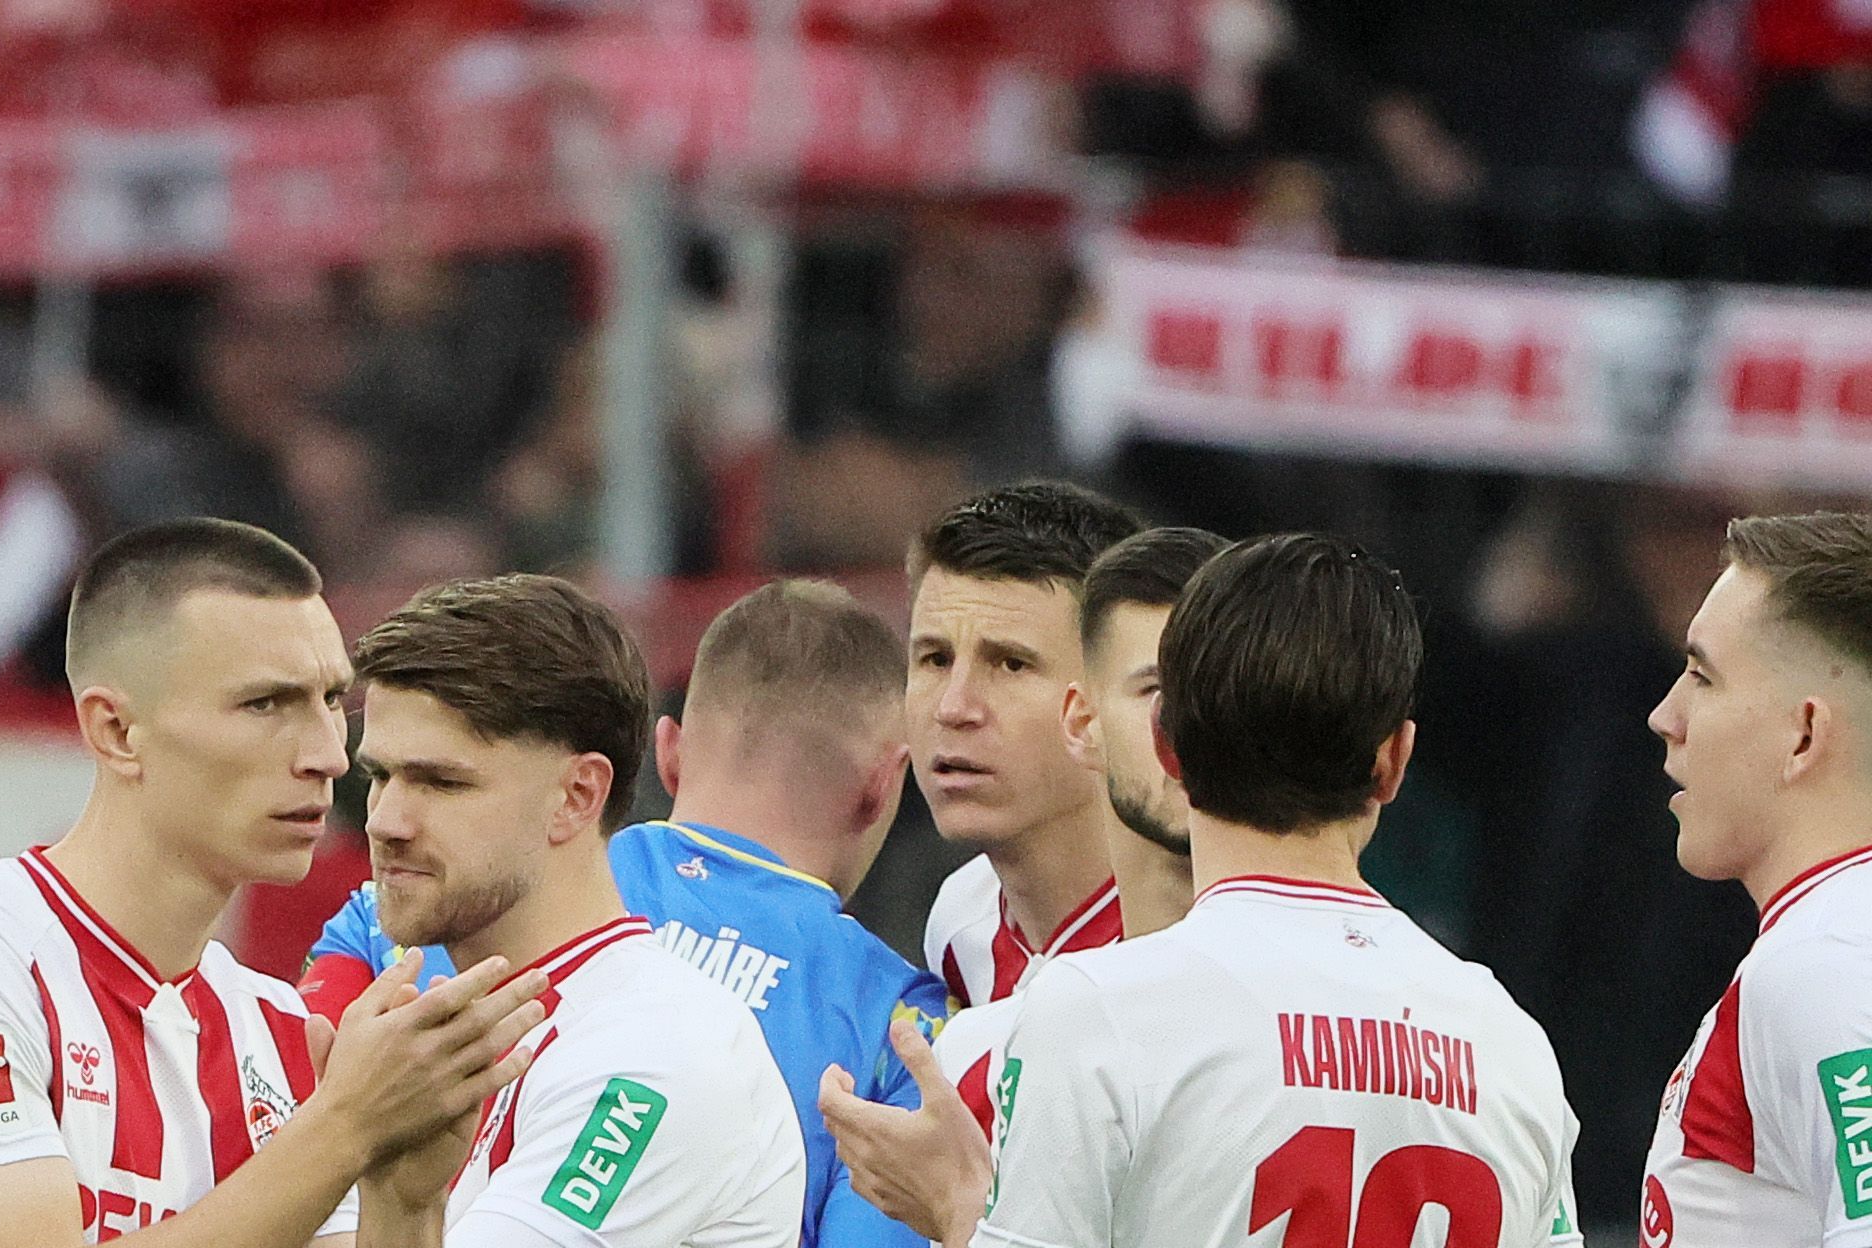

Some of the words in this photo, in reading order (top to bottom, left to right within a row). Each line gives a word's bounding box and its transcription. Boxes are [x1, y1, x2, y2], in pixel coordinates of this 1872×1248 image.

[67, 1080, 110, 1106] hummel
[1278, 1007, 1477, 1115] KAMIŃSKI
[560, 1089, 652, 1214] DEVK
